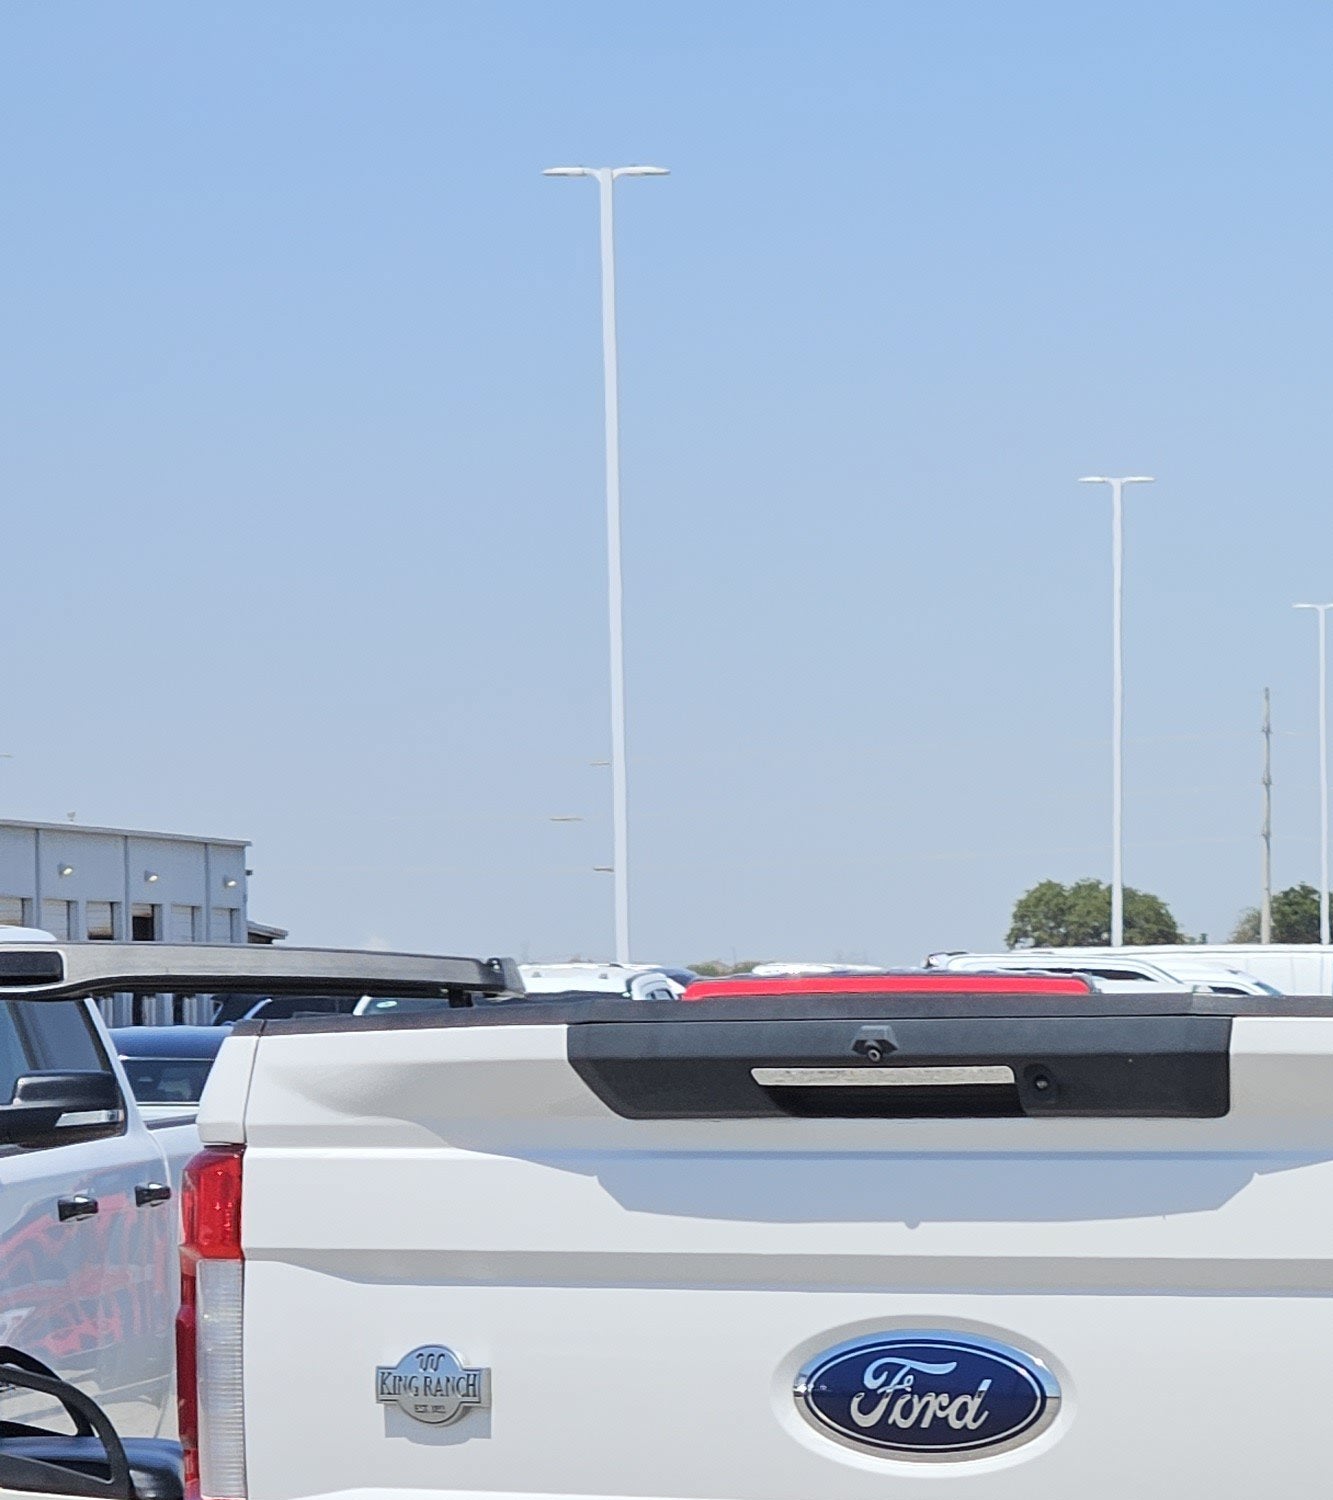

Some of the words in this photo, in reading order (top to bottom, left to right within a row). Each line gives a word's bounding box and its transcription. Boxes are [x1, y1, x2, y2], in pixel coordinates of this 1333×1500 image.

[380, 1371, 419, 1397] KING
[423, 1373, 478, 1398] RANCH
[850, 1356, 993, 1430] Ford
